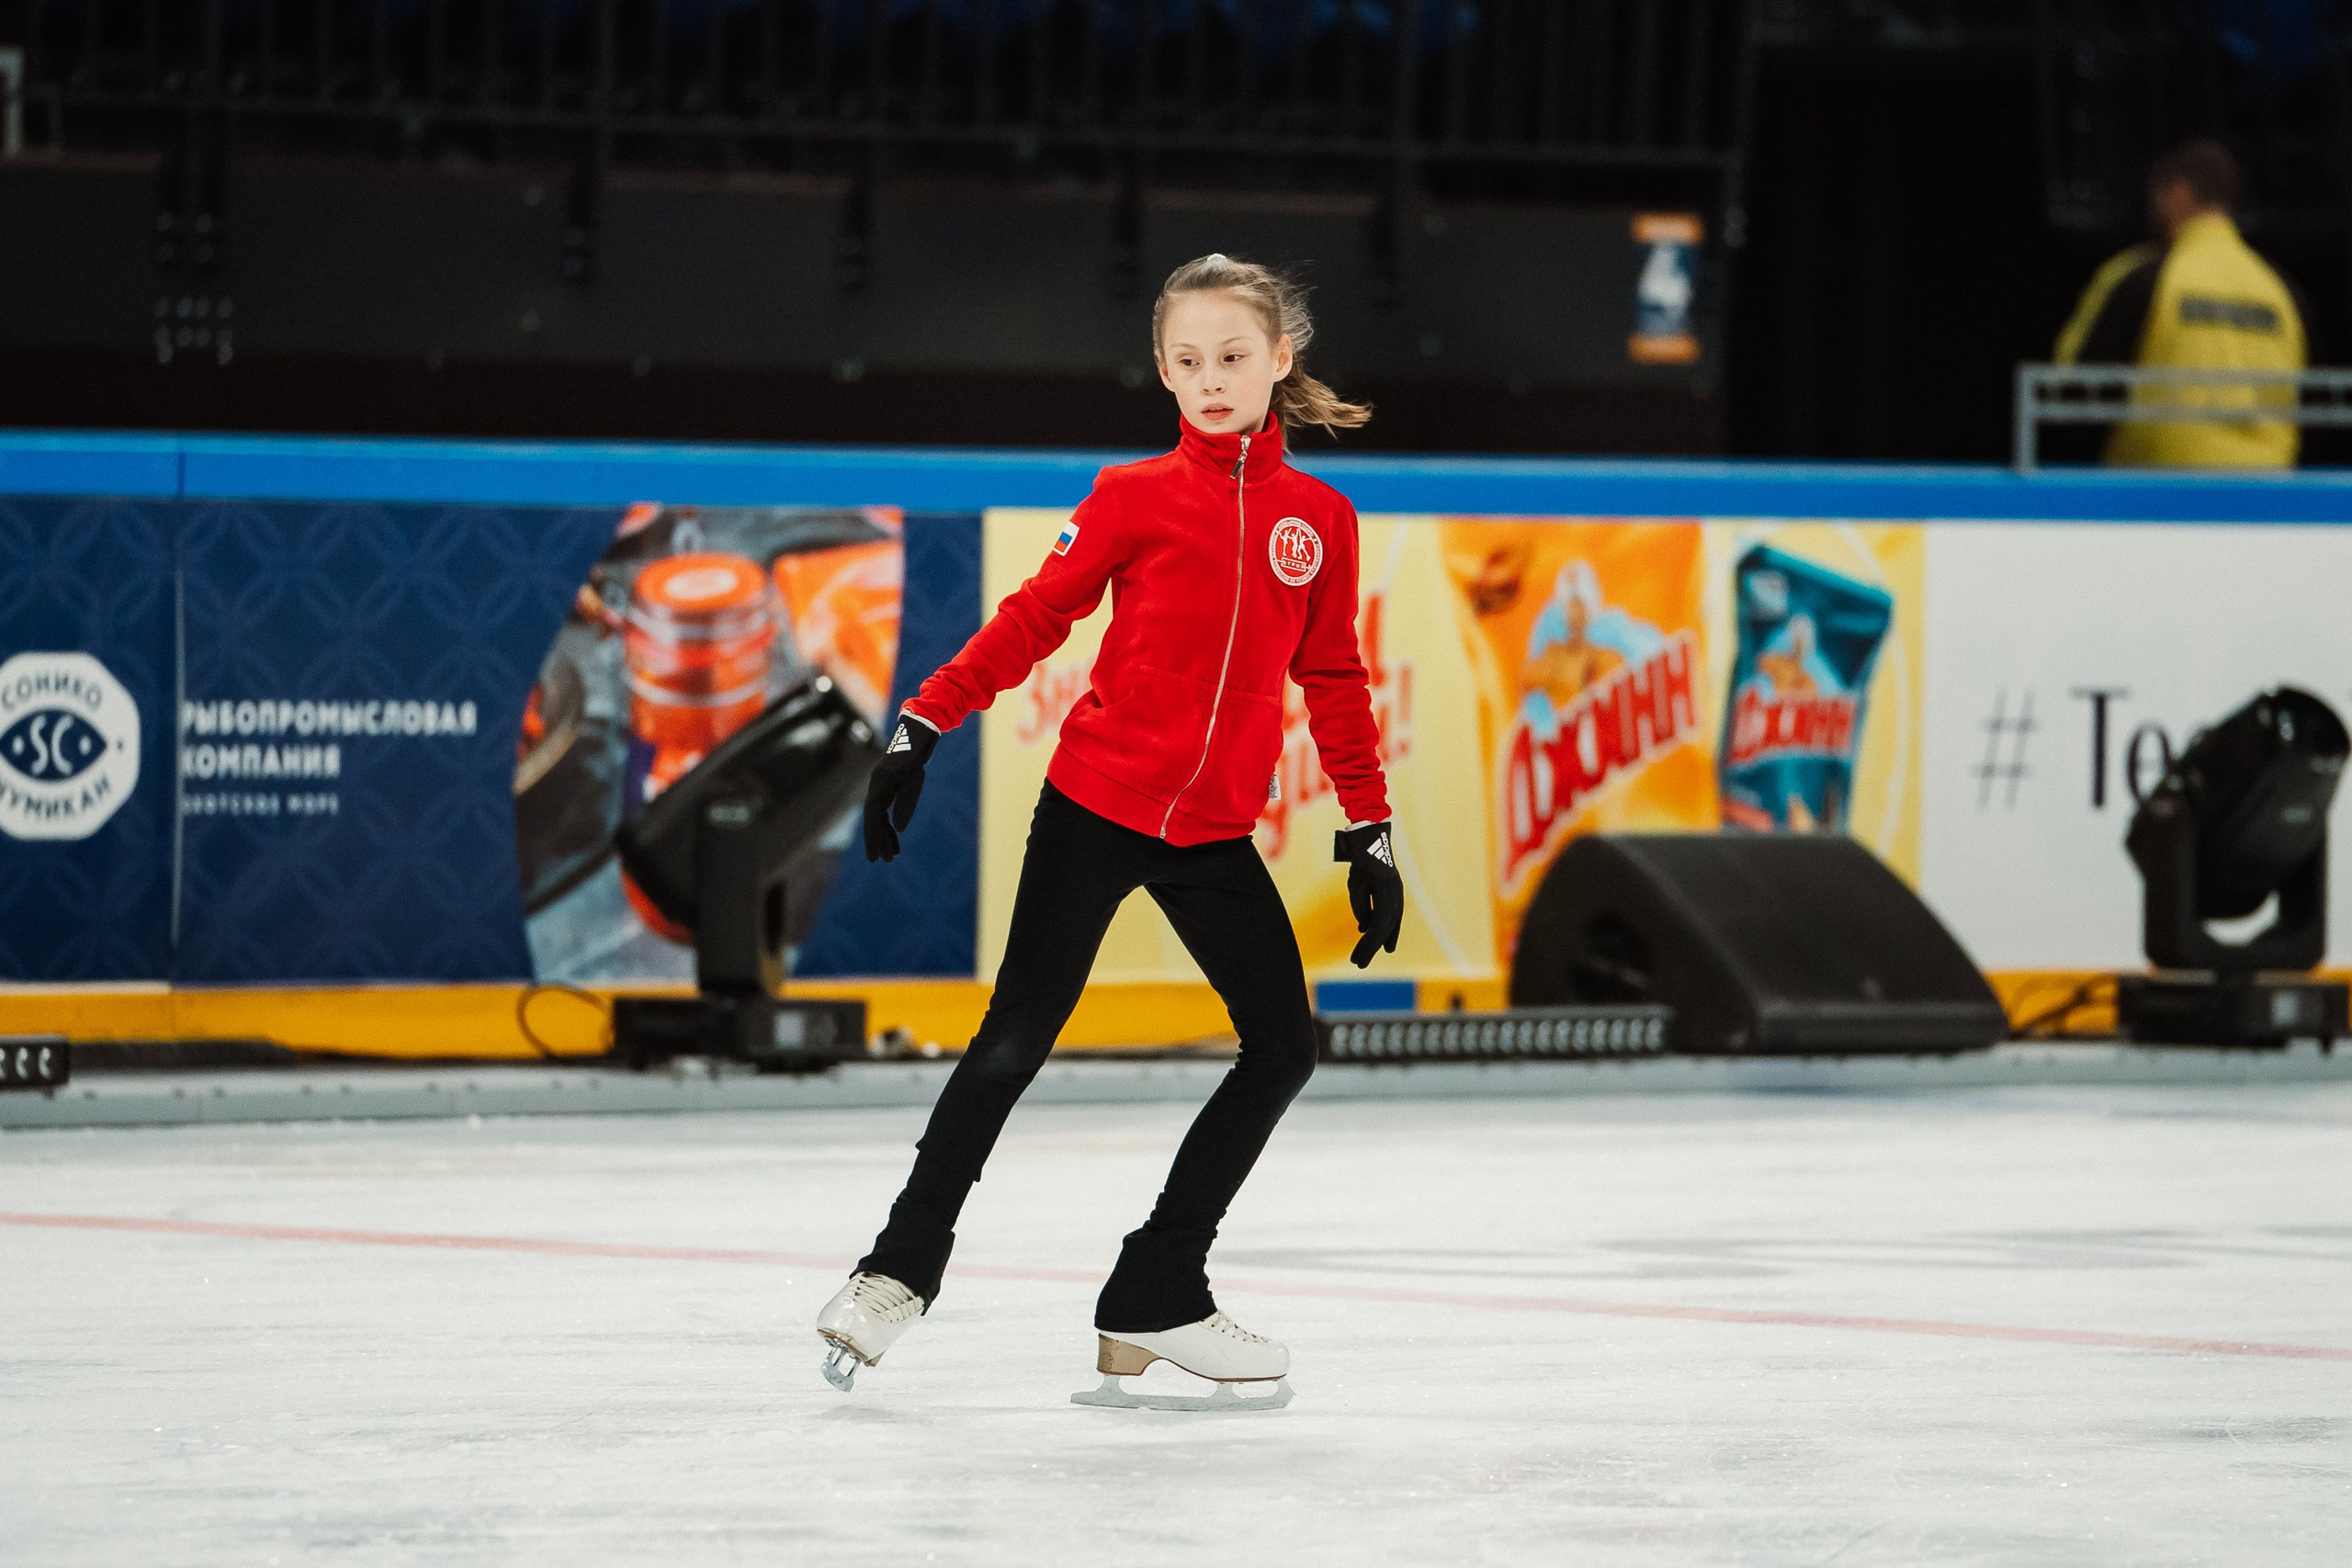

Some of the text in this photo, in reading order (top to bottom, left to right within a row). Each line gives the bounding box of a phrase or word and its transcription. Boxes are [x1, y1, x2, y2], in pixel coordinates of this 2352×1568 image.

[181, 699, 478, 736] РЫБОПРОМЫСЛОВАЯ
[182, 743, 341, 779] КОМПАНИЯ
[1380, 831, 1394, 867] adidas
